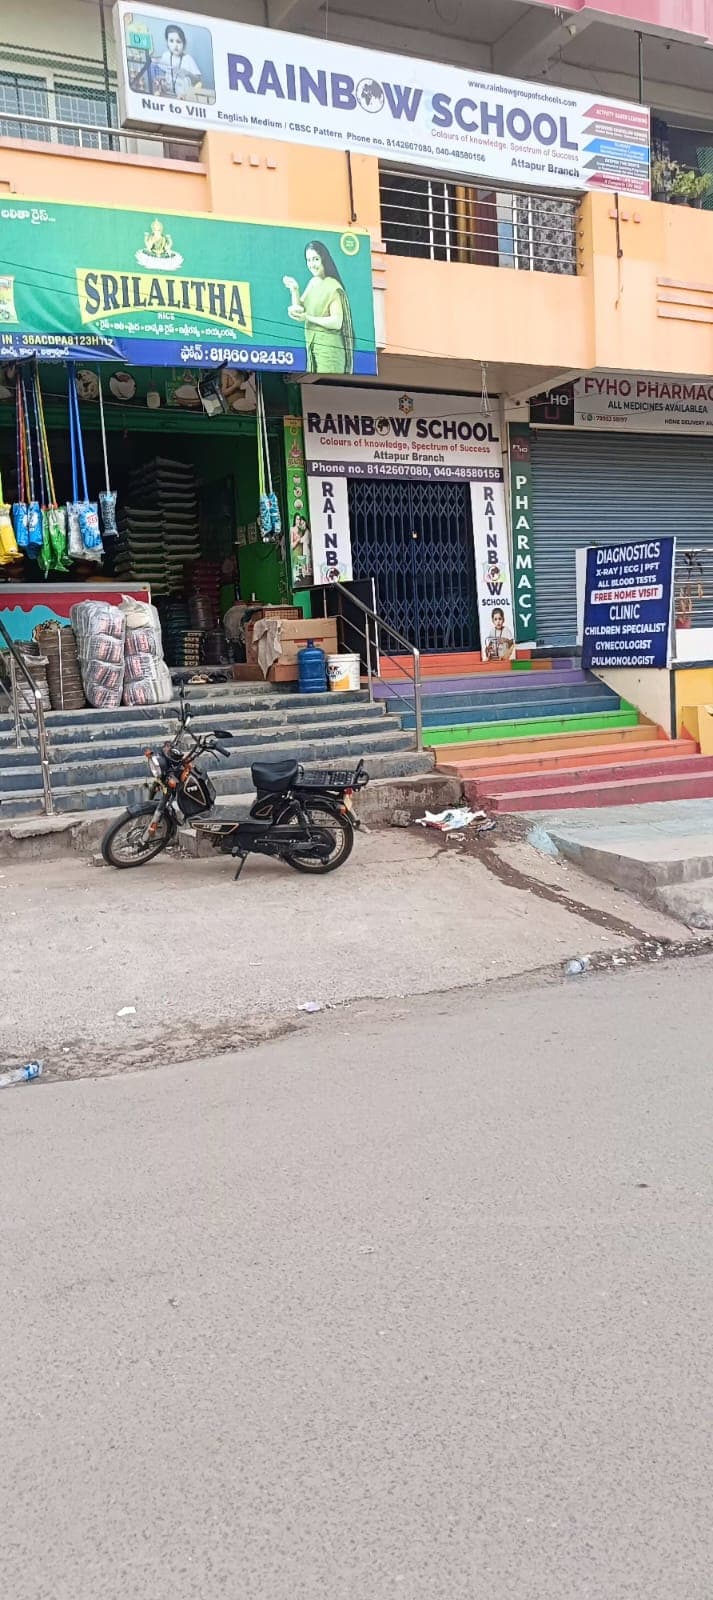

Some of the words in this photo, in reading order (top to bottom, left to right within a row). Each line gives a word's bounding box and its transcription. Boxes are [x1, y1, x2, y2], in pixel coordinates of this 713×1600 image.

[468, 79, 577, 107] www.rainbowgroupofschools.com
[141, 98, 165, 113] Nur
[169, 103, 182, 116] to
[186, 105, 207, 118] VIII
[217, 110, 249, 124] English
[250, 116, 283, 129] Medium
[289, 122, 312, 134] CBSC
[313, 126, 343, 139] Pattern
[347, 132, 371, 144] Phone
[372, 137, 385, 146] no.
[431, 92, 579, 151] SCHOOL
[431, 128, 459, 142] Colours
[460, 133, 470, 143] of
[510, 142, 542, 156] Spectrum
[543, 148, 551, 157] of
[551, 149, 579, 162] Success
[511, 157, 546, 173] Attapur
[548, 164, 580, 178] Branch
[84, 271, 247, 328] SRILALITHA
[158, 312, 175, 321] RICE
[210, 347, 249, 363] 81860
[250, 350, 294, 365] 02453
[584, 377, 631, 397] FYHO
[608, 401, 622, 410] ALL
[623, 402, 664, 412] MEDICINES
[416, 418, 499, 443] SCHOOL
[320, 437, 352, 447] Colours
[354, 438, 363, 447] of
[364, 439, 410, 451] knowledge,
[411, 441, 448, 453] Spectrum
[450, 443, 458, 452] of
[459, 444, 491, 454] Success
[374, 450, 409, 463] Attapur
[412, 452, 445, 463] Branch
[312, 462, 345, 474] Phone
[348, 465, 365, 474] no.
[367, 465, 432, 479] 8142607080,
[433, 467, 500, 479] 040-48580156
[515, 475, 532, 628] PHARMACY
[596, 542, 660, 565] DIAGNOSTICS
[596, 566, 619, 577] X-RAY
[624, 565, 640, 574] ECG
[645, 562, 660, 571] PFT
[598, 580, 610, 588] ALL
[611, 577, 635, 587] BLOOD
[636, 575, 657, 585] TESTS
[482, 598, 511, 607] SCHOOL
[594, 592, 613, 602] FREE
[614, 590, 636, 600] HOME
[638, 587, 659, 598] VISIT
[609, 604, 641, 621] CLINIC
[585, 625, 621, 636] CHILDREN
[622, 622, 667, 634] SPECIALIST
[595, 639, 652, 651] GYNECOLOGIST
[591, 655, 655, 666] PULMONOLOGIST
